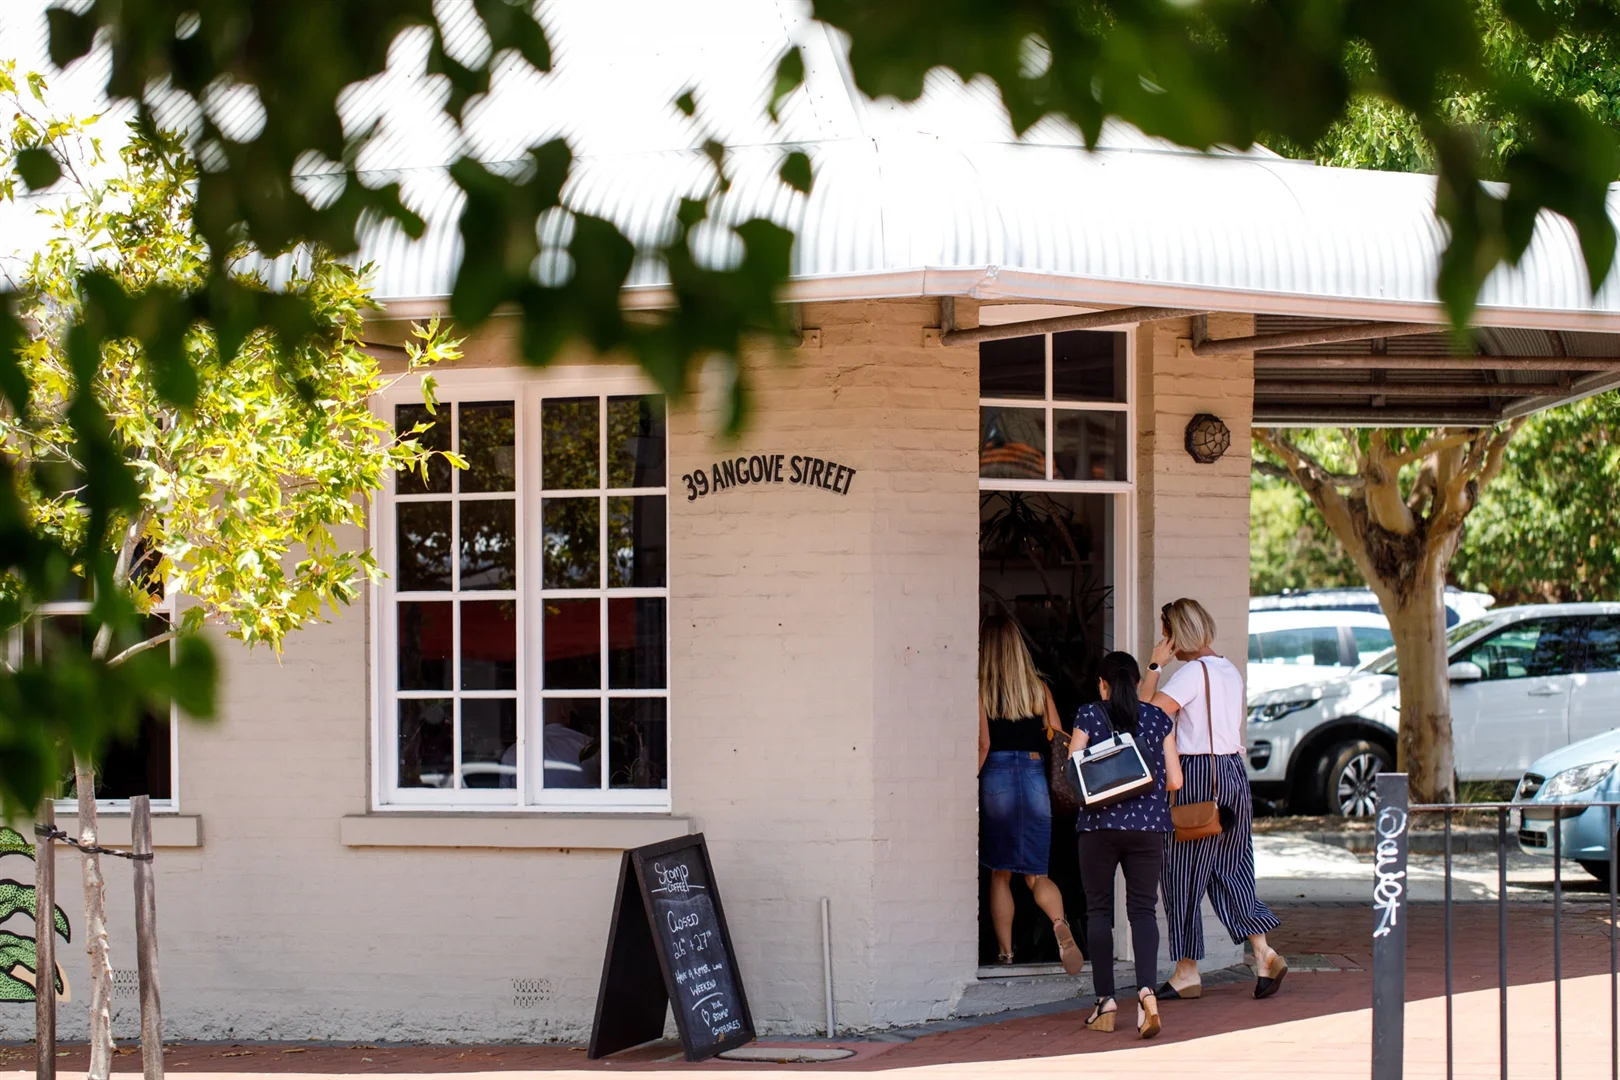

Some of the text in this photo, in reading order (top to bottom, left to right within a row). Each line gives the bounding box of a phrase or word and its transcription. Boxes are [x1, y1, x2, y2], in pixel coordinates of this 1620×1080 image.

[682, 455, 857, 501] 39 ANGOVE STREET
[667, 881, 688, 893] COFFEE
[667, 910, 699, 933] CLOSED
[675, 969, 688, 985] HAVE
[688, 969, 695, 980] A
[690, 979, 717, 996] WEEKEND
[712, 1008, 729, 1022] STOMP
[711, 1019, 741, 1036] COMPADRES
